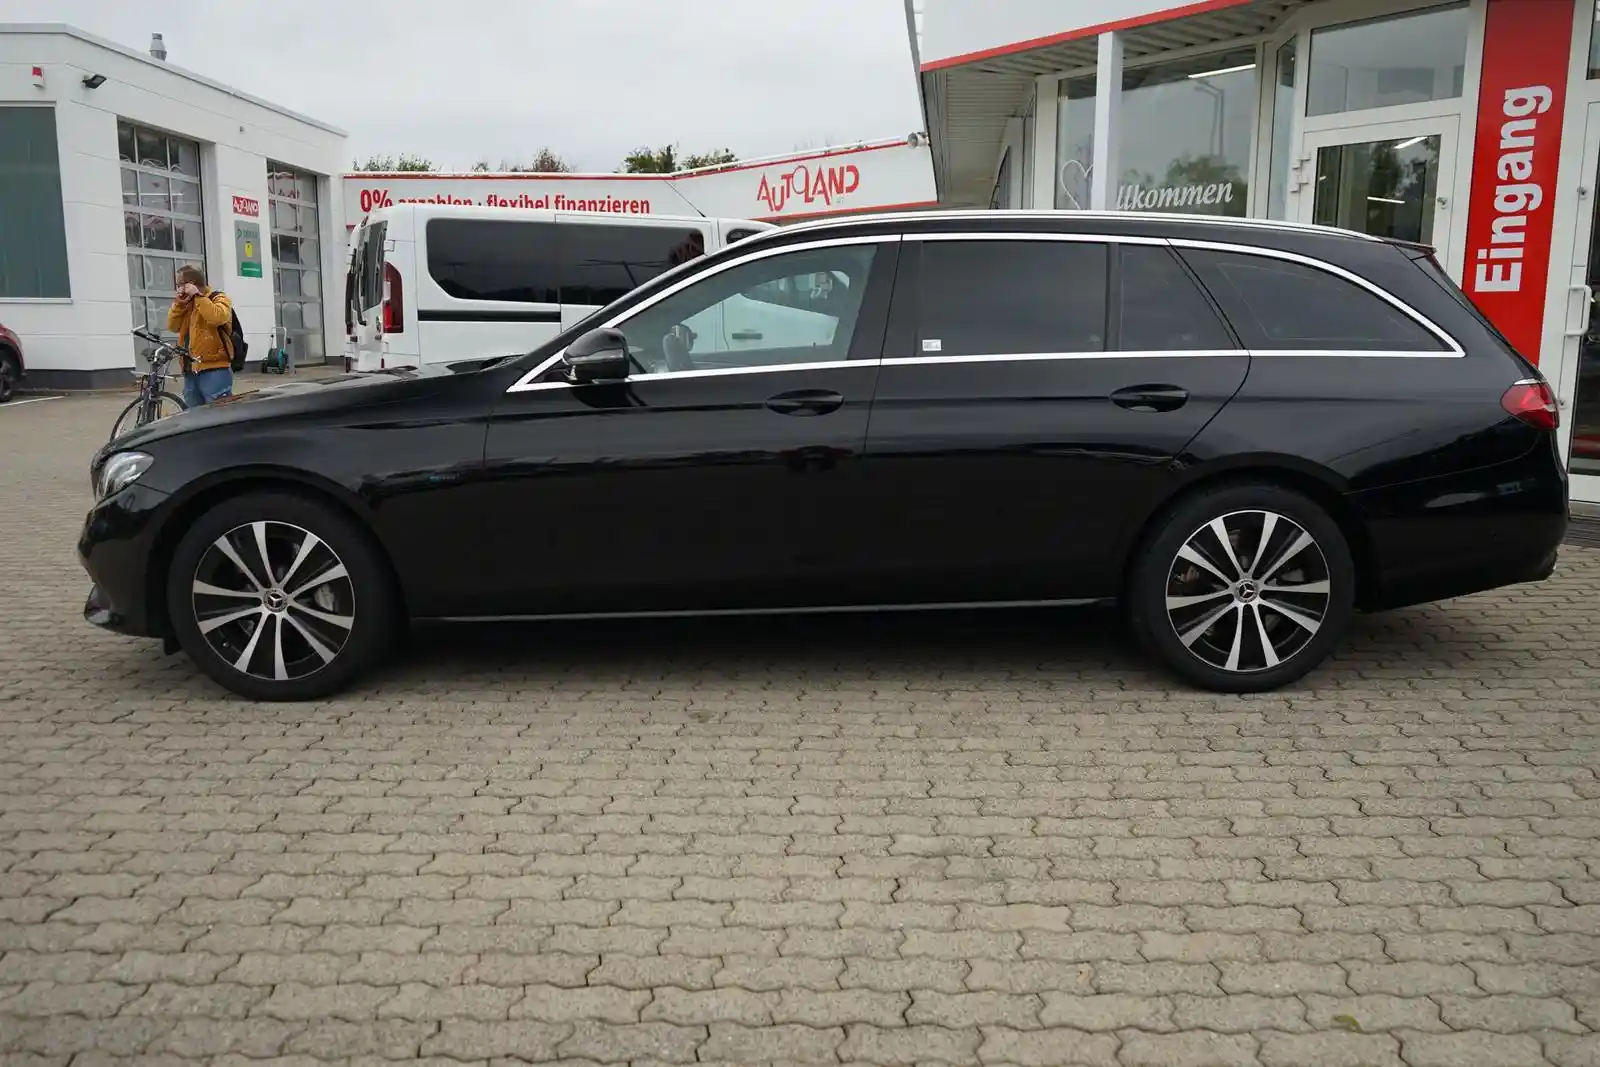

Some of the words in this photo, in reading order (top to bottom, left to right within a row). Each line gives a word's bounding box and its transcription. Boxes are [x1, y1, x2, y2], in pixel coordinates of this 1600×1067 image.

[360, 189, 393, 213] 0%
[554, 194, 651, 214] finanzieren
[757, 164, 860, 212] AUTOLAND
[1116, 181, 1234, 210] llkommen
[1475, 84, 1553, 292] Eingang
